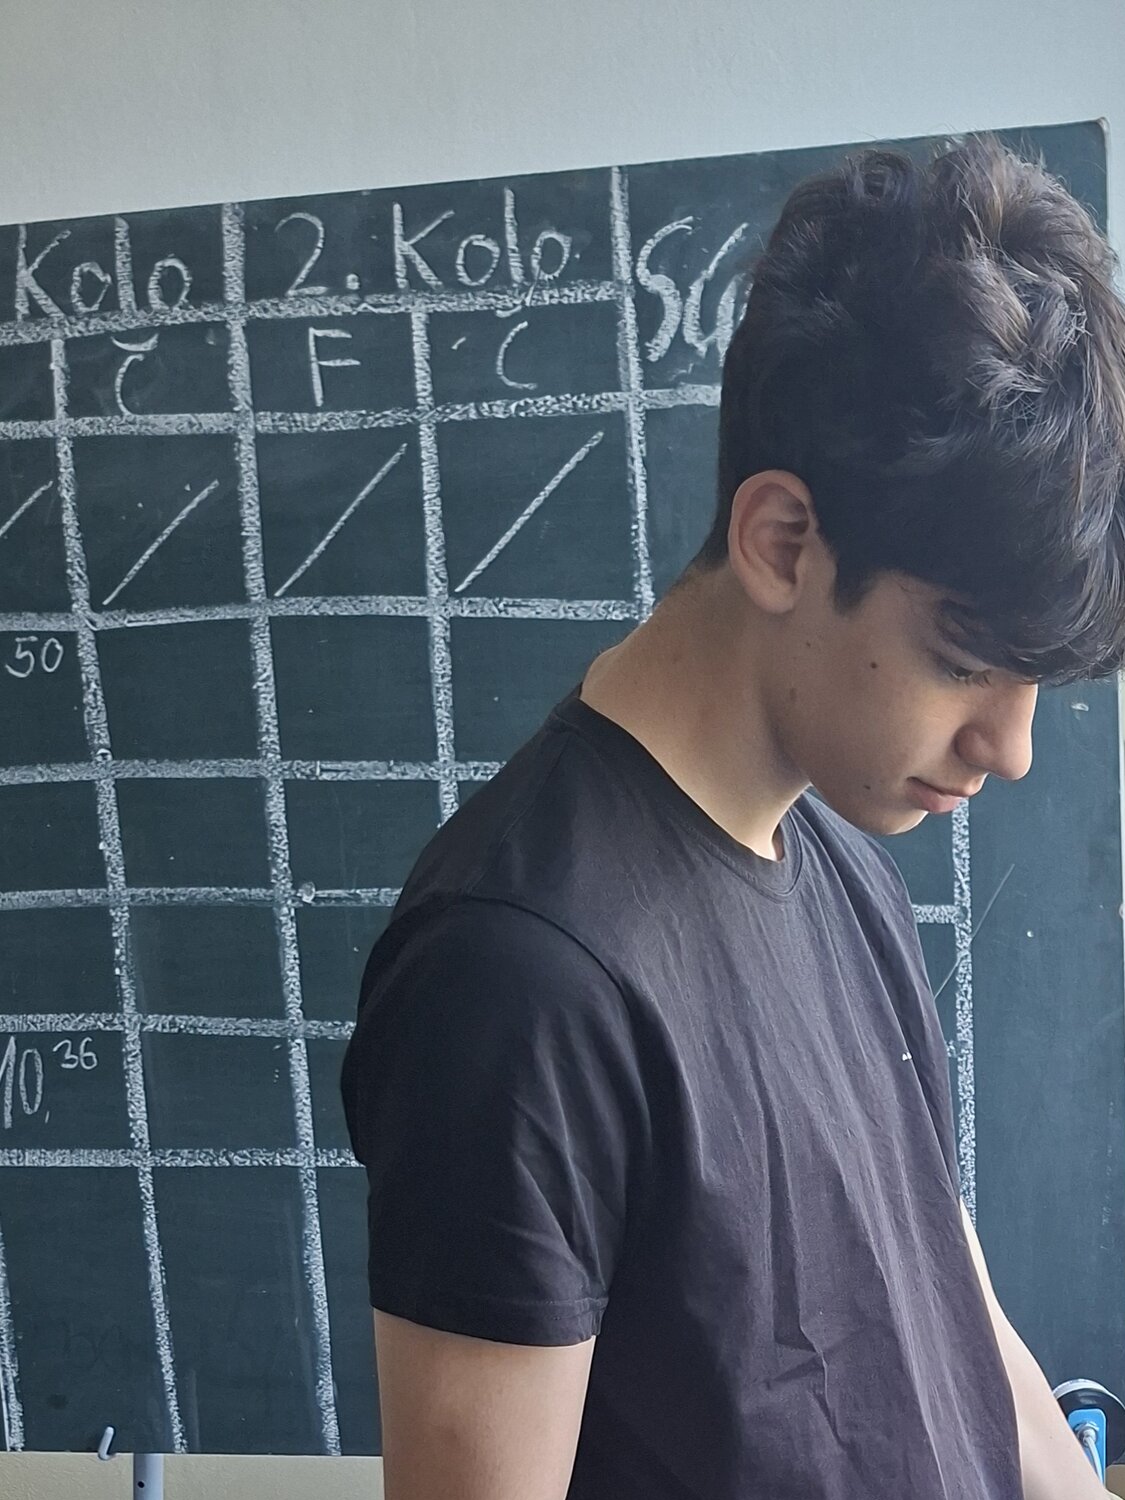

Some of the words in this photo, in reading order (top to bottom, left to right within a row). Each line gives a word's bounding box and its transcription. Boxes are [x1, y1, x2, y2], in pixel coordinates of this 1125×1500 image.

[15, 216, 193, 321] Kolo
[275, 212, 361, 297] 2.
[393, 187, 573, 292] Kolo
[309, 327, 361, 407] F
[5, 636, 64, 678] 50
[53, 1037, 98, 1070] 36
